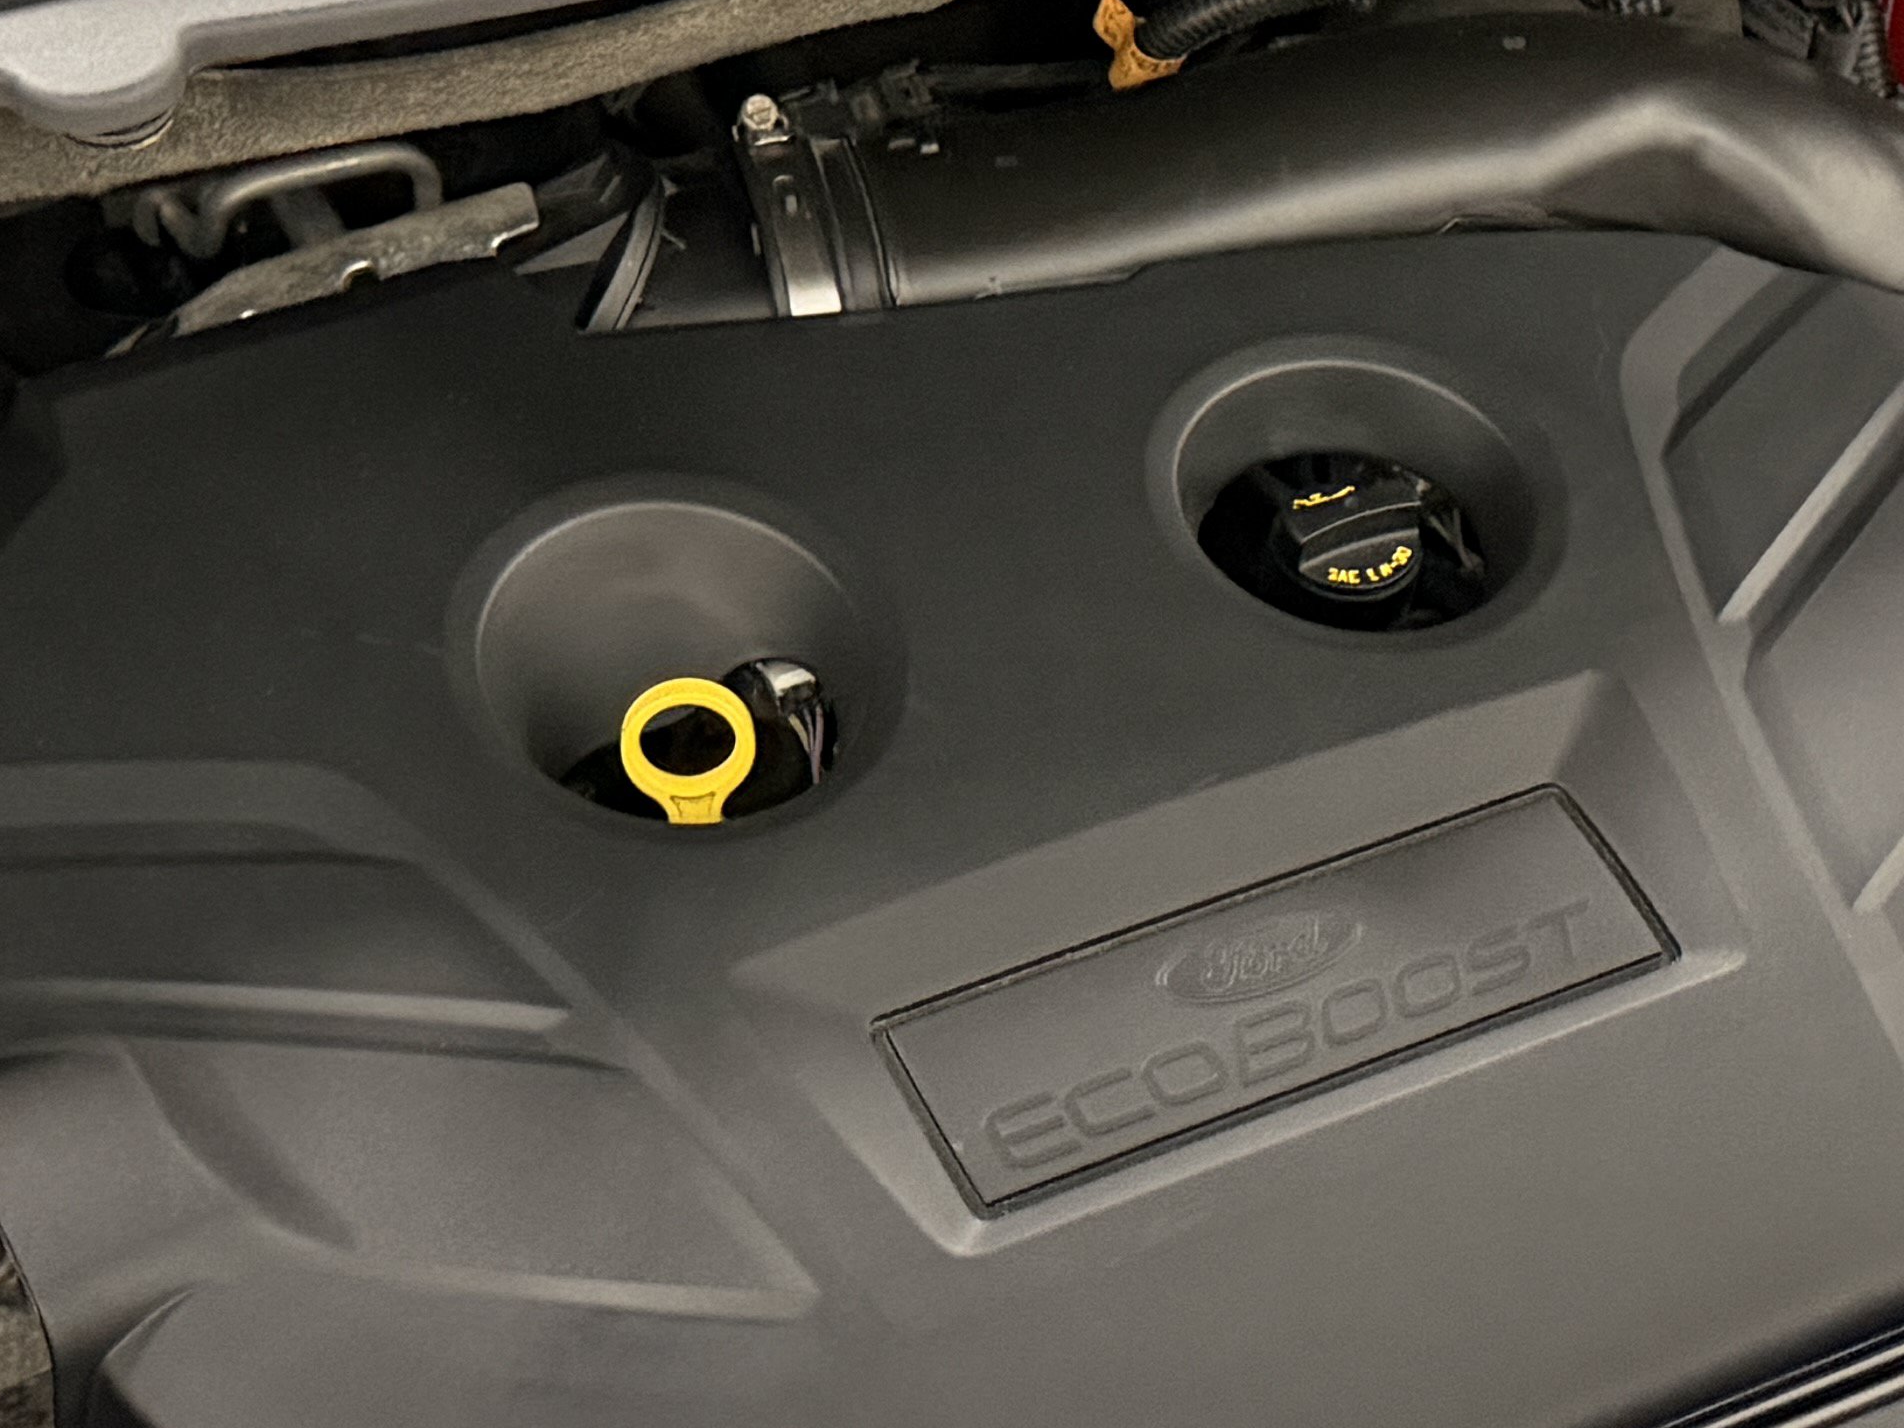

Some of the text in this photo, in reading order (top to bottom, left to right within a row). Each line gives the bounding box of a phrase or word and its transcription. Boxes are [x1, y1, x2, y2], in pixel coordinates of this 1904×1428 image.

[1327, 566, 1361, 585] SAE
[1202, 910, 1341, 996] Ford
[984, 898, 1591, 1174] ECOBOOST
